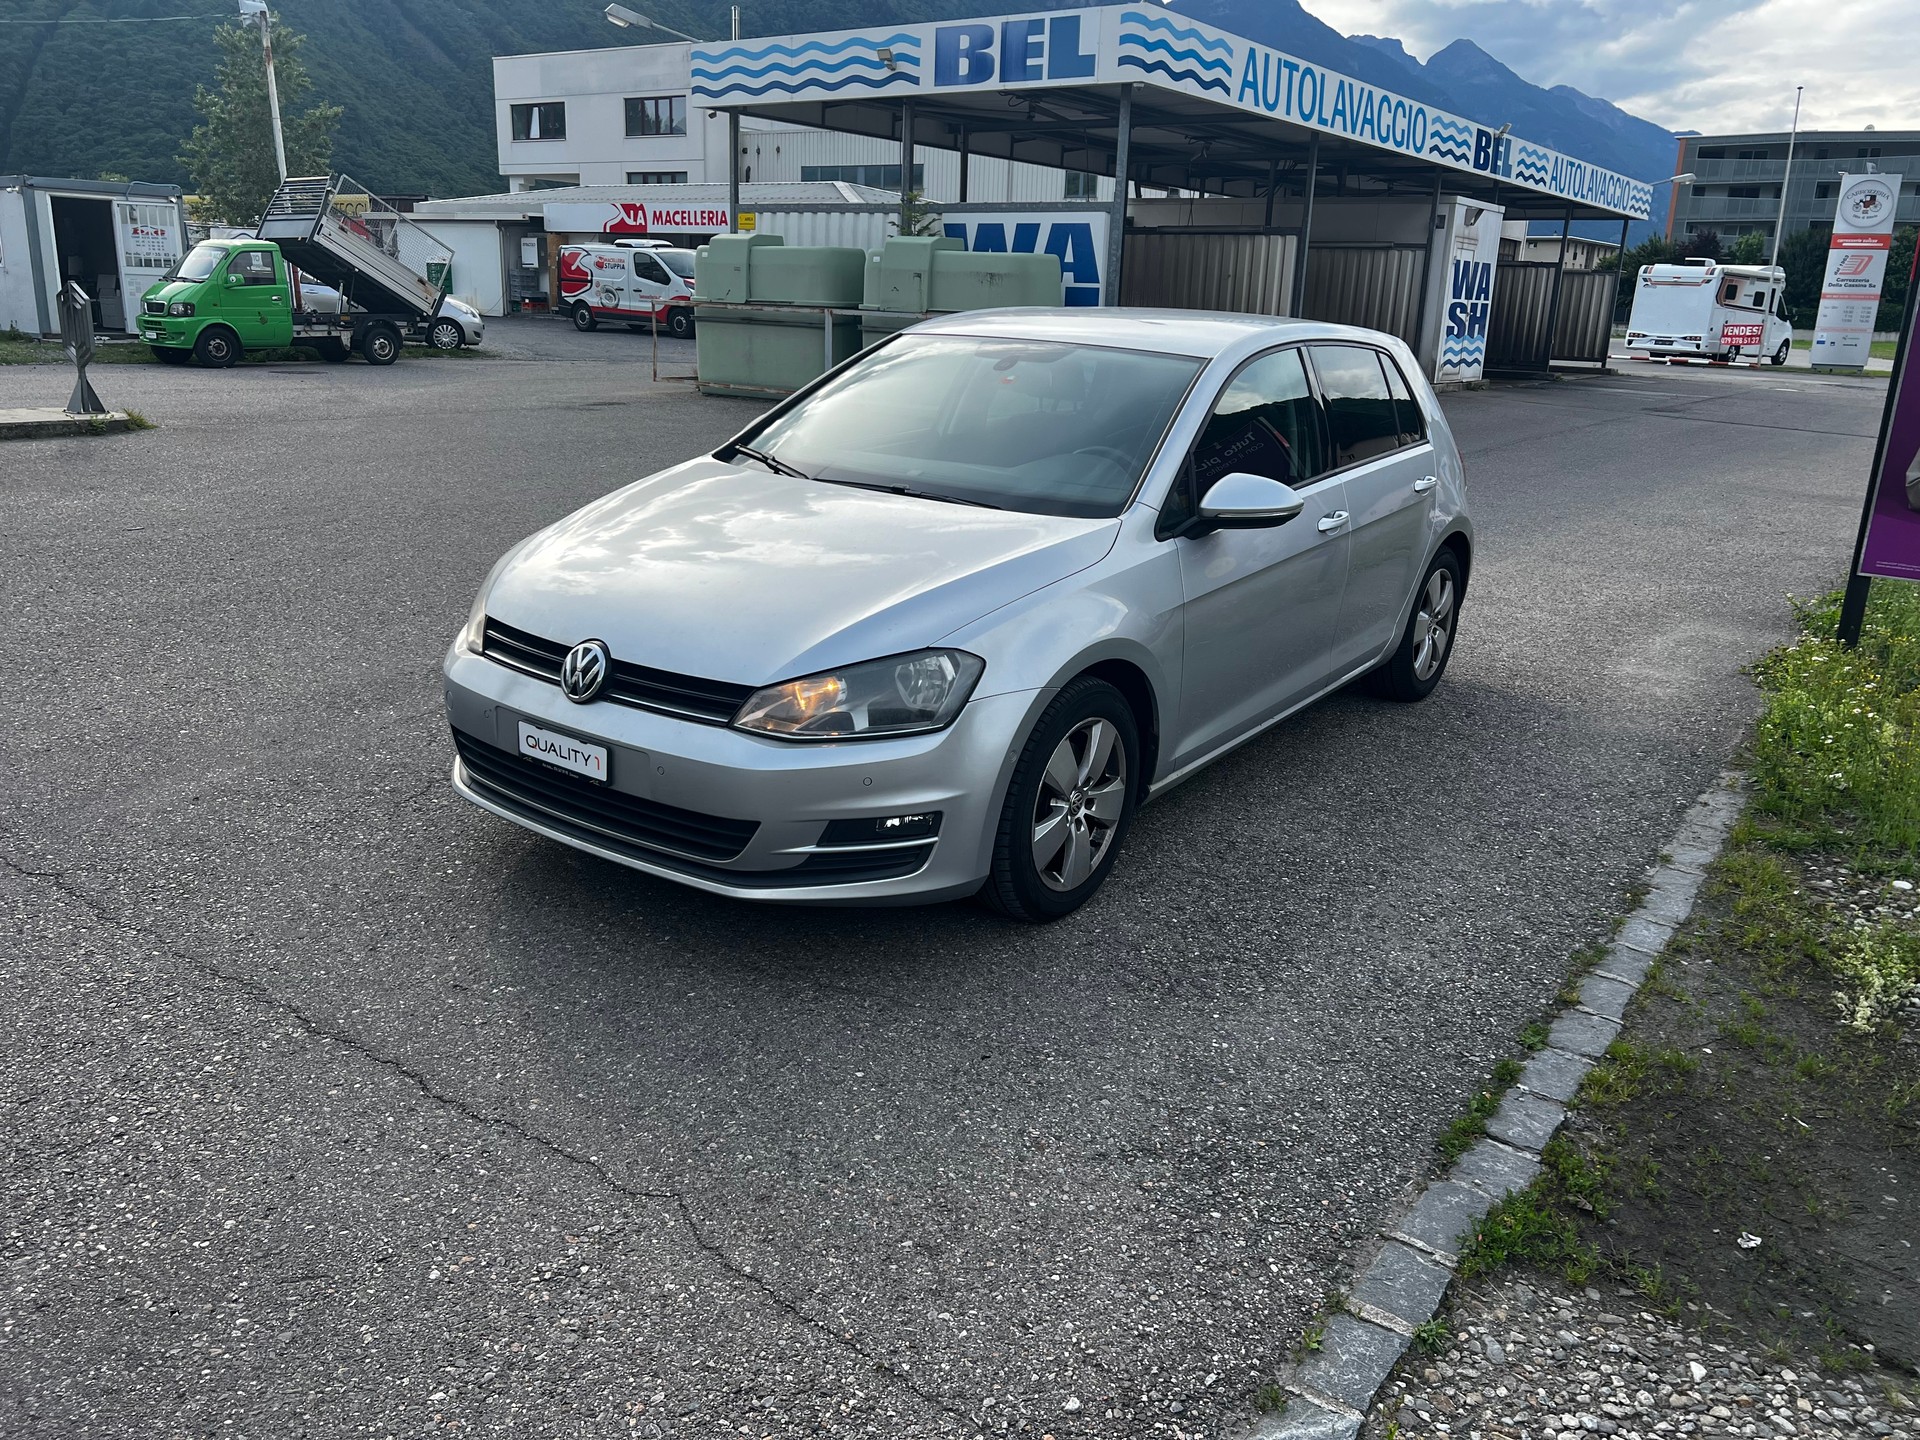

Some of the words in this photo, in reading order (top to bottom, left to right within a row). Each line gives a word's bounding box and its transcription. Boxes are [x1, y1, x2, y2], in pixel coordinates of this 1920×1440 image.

[934, 14, 1097, 87] BEL
[1237, 46, 1428, 155] AUTOLAVAGGIO
[1472, 127, 1513, 179] BEL
[1549, 155, 1631, 212] AUTOLAVAGGIO
[652, 210, 729, 226] MACELLERIA
[604, 262, 626, 271] STUPPIA
[1452, 259, 1492, 301] WA
[1445, 301, 1489, 340] SH
[1724, 326, 1762, 336] VENDESI
[525, 734, 592, 767] QUALITY
